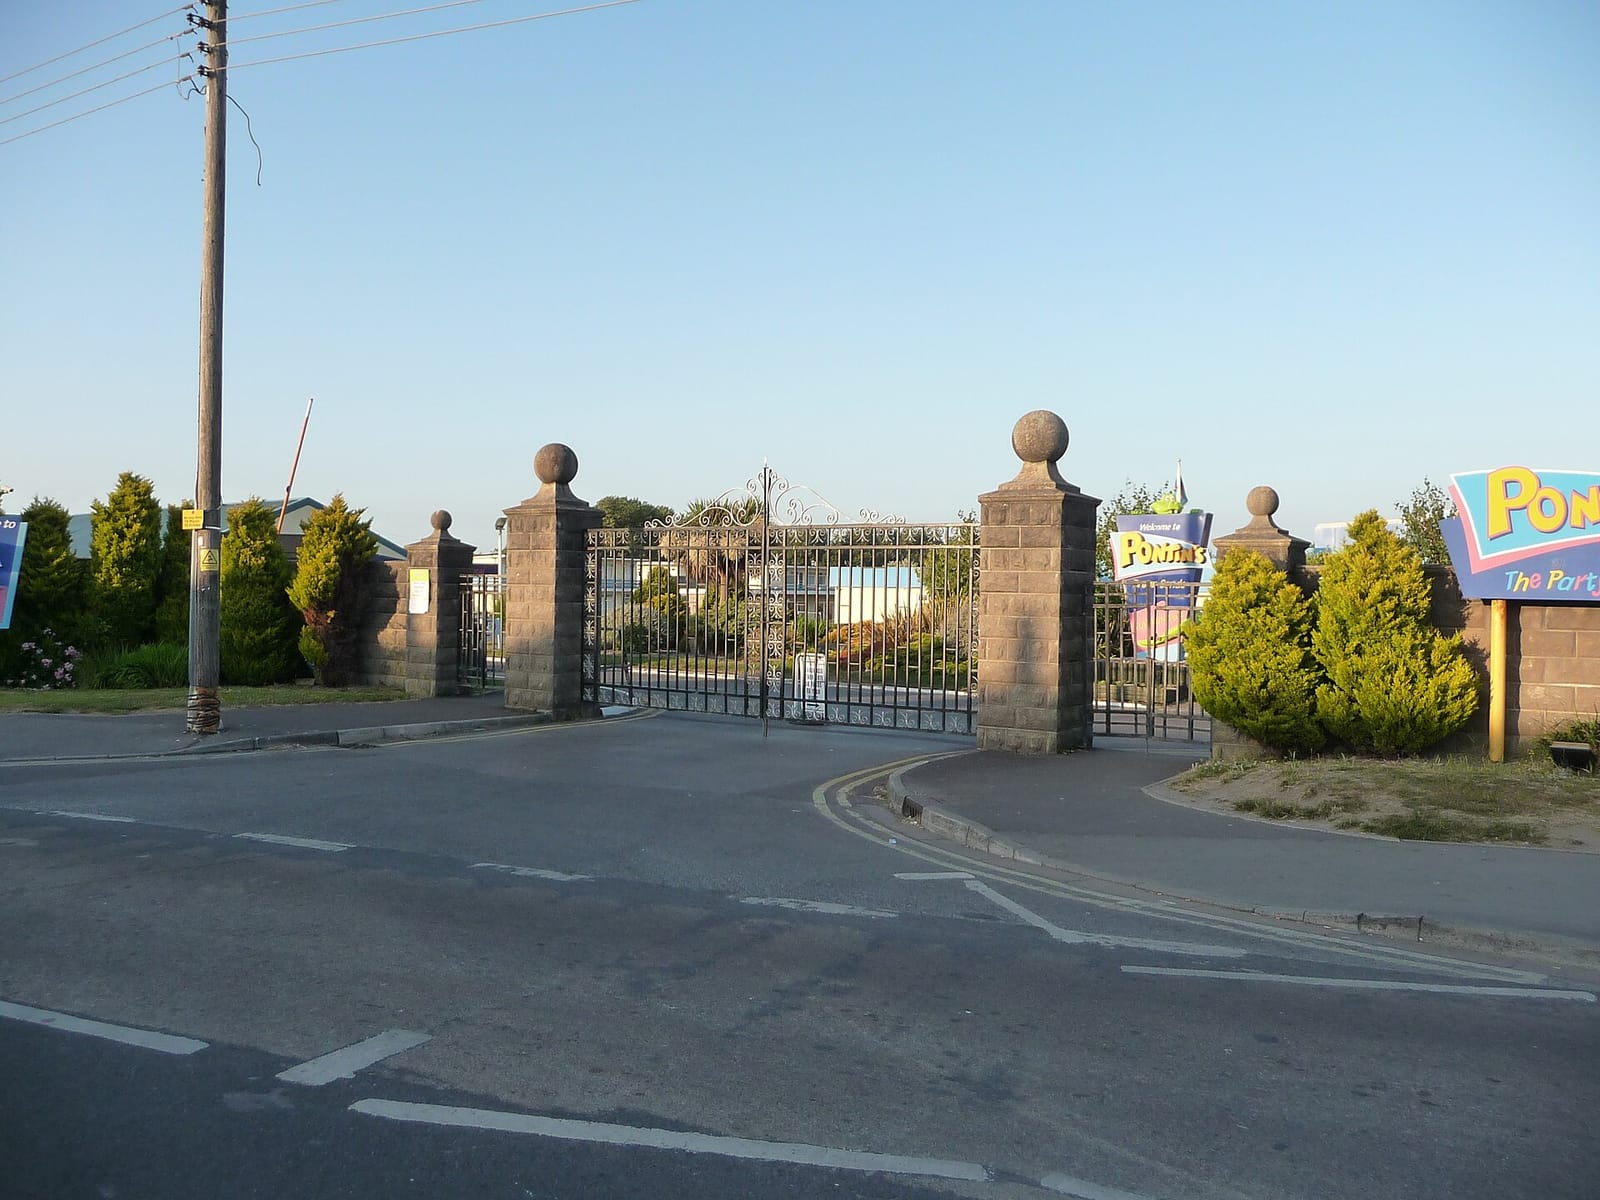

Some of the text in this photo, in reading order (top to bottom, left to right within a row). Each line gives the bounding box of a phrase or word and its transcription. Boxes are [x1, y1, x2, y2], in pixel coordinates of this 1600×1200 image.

[3, 519, 17, 529] to
[1139, 523, 1181, 531] Welcome to
[1505, 570, 1542, 592] The
